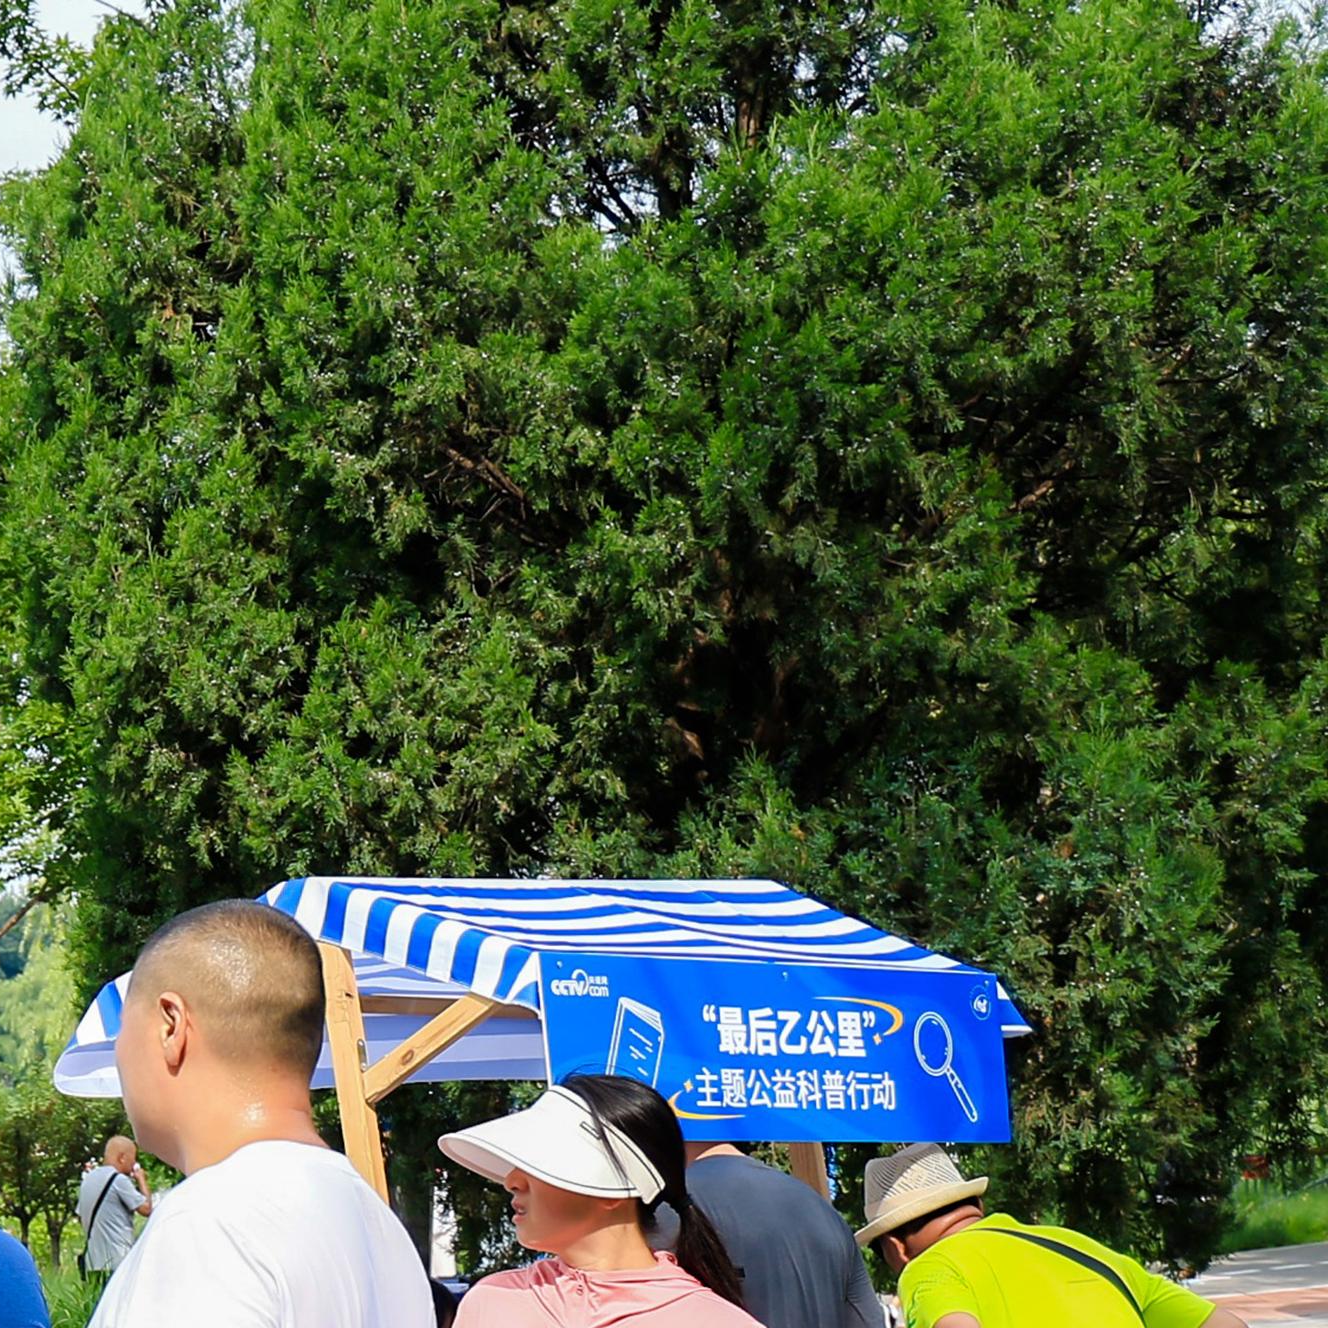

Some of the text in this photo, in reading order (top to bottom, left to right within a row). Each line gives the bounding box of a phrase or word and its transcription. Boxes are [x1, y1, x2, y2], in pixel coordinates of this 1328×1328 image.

[702, 1005, 876, 1058] “最后乙公里”
[694, 1067, 896, 1111] 主题公益科普行动
